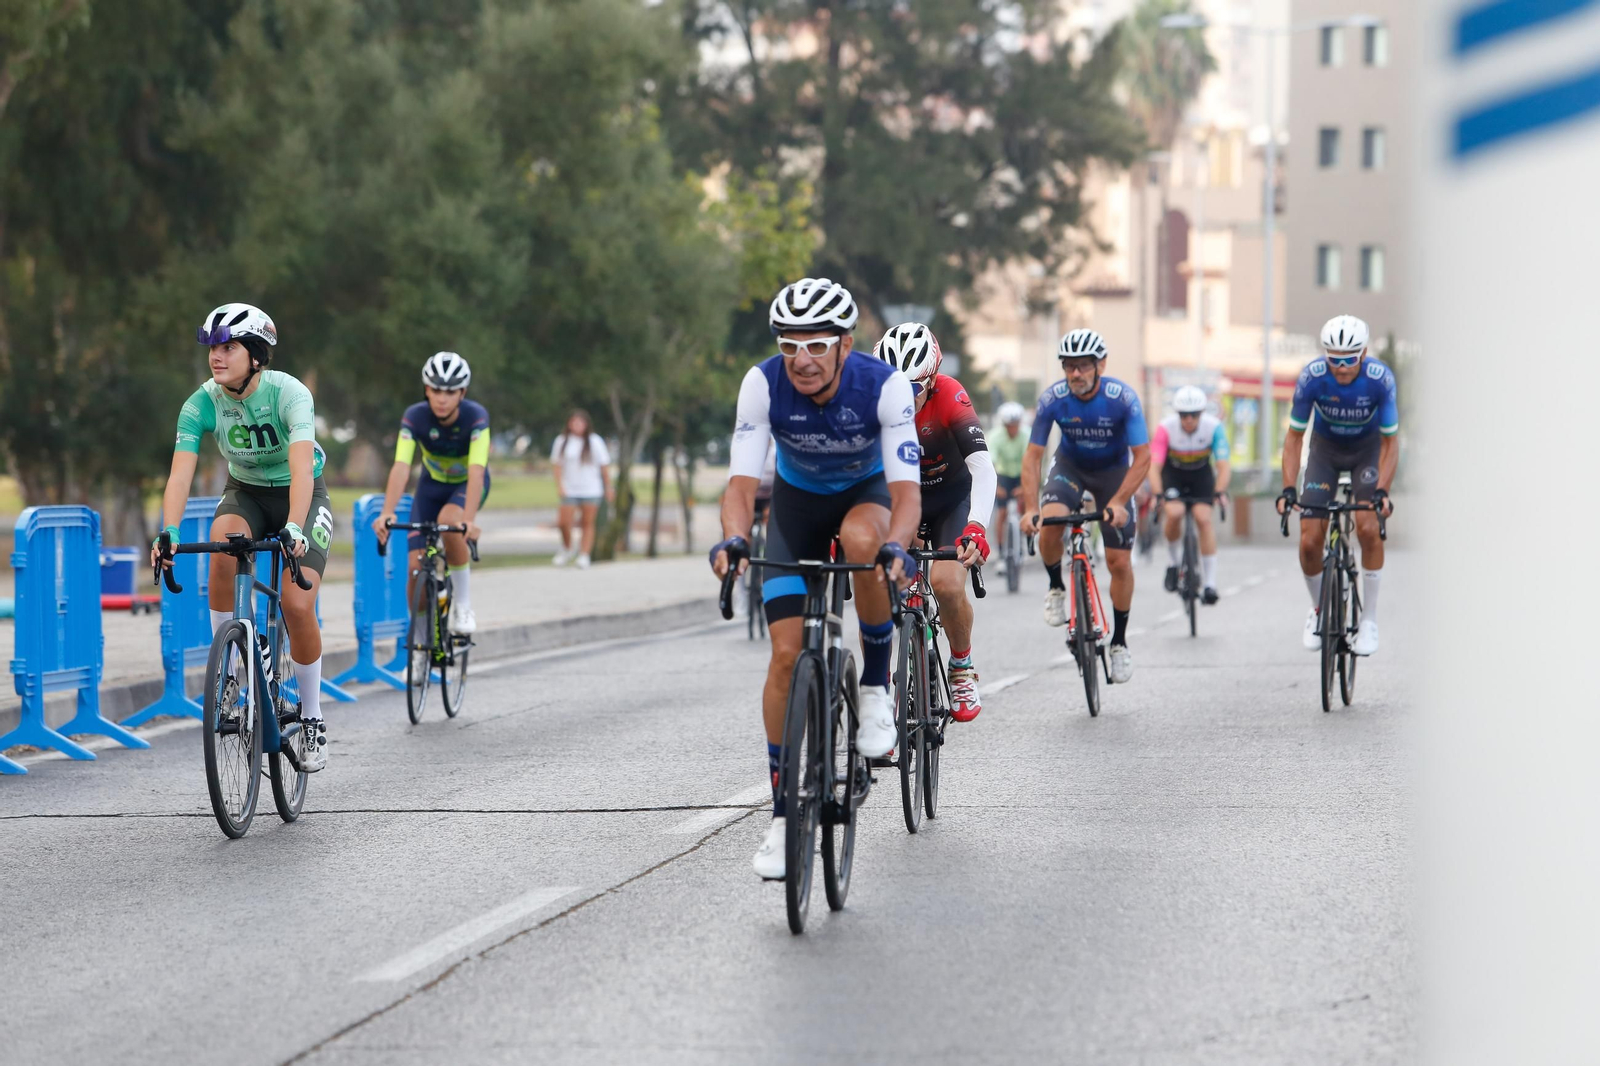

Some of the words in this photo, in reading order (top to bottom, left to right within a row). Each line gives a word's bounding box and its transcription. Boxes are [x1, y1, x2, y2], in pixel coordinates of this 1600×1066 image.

[1321, 405, 1370, 418] MIRANDA
[227, 423, 280, 449] em
[1063, 427, 1113, 437] MIRANDA
[228, 446, 283, 457] electromercantil
[312, 506, 333, 549] em
